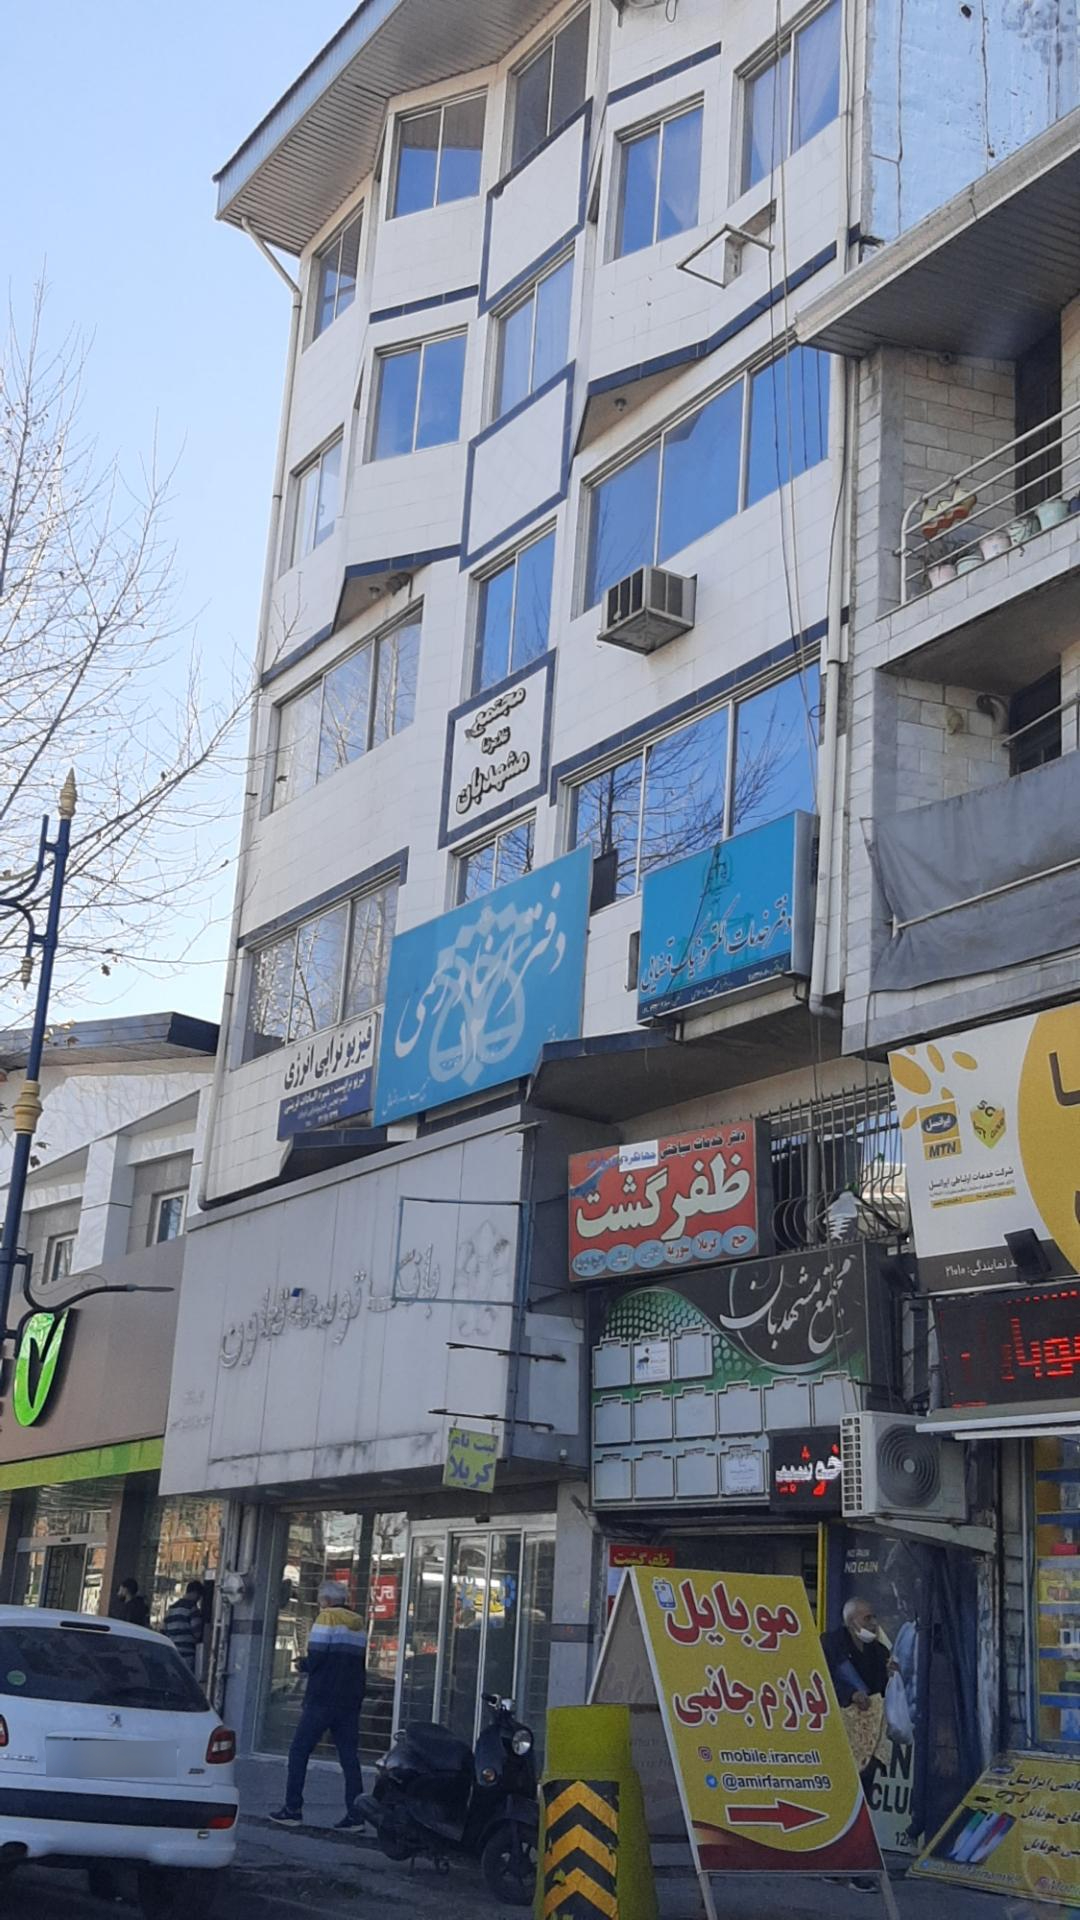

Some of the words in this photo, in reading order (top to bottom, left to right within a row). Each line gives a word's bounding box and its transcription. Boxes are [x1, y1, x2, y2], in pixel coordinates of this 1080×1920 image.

[765, 893, 793, 950] دفتر
[671, 893, 742, 979] الکترونیک
[727, 909, 770, 954] خدمات
[284, 1044, 315, 1090] انرژی
[694, 1136, 724, 1151] خدمات
[727, 1129, 746, 1147] دفتر
[928, 1140, 957, 1159] MTN
[972, 1170, 994, 1181] خدمات
[995, 1166, 1014, 1178] شرکت
[698, 1237, 717, 1252] کربلا
[731, 1233, 748, 1249] حج
[807, 1253, 857, 1354] مجتمع
[666, 1578, 800, 1650] موبایل
[672, 1664, 756, 1728] جانبی
[758, 1668, 829, 1731] لوازم
[719, 1748, 822, 1766] mobile.irancell
[722, 1772, 832, 1791] @amirfarnam99
